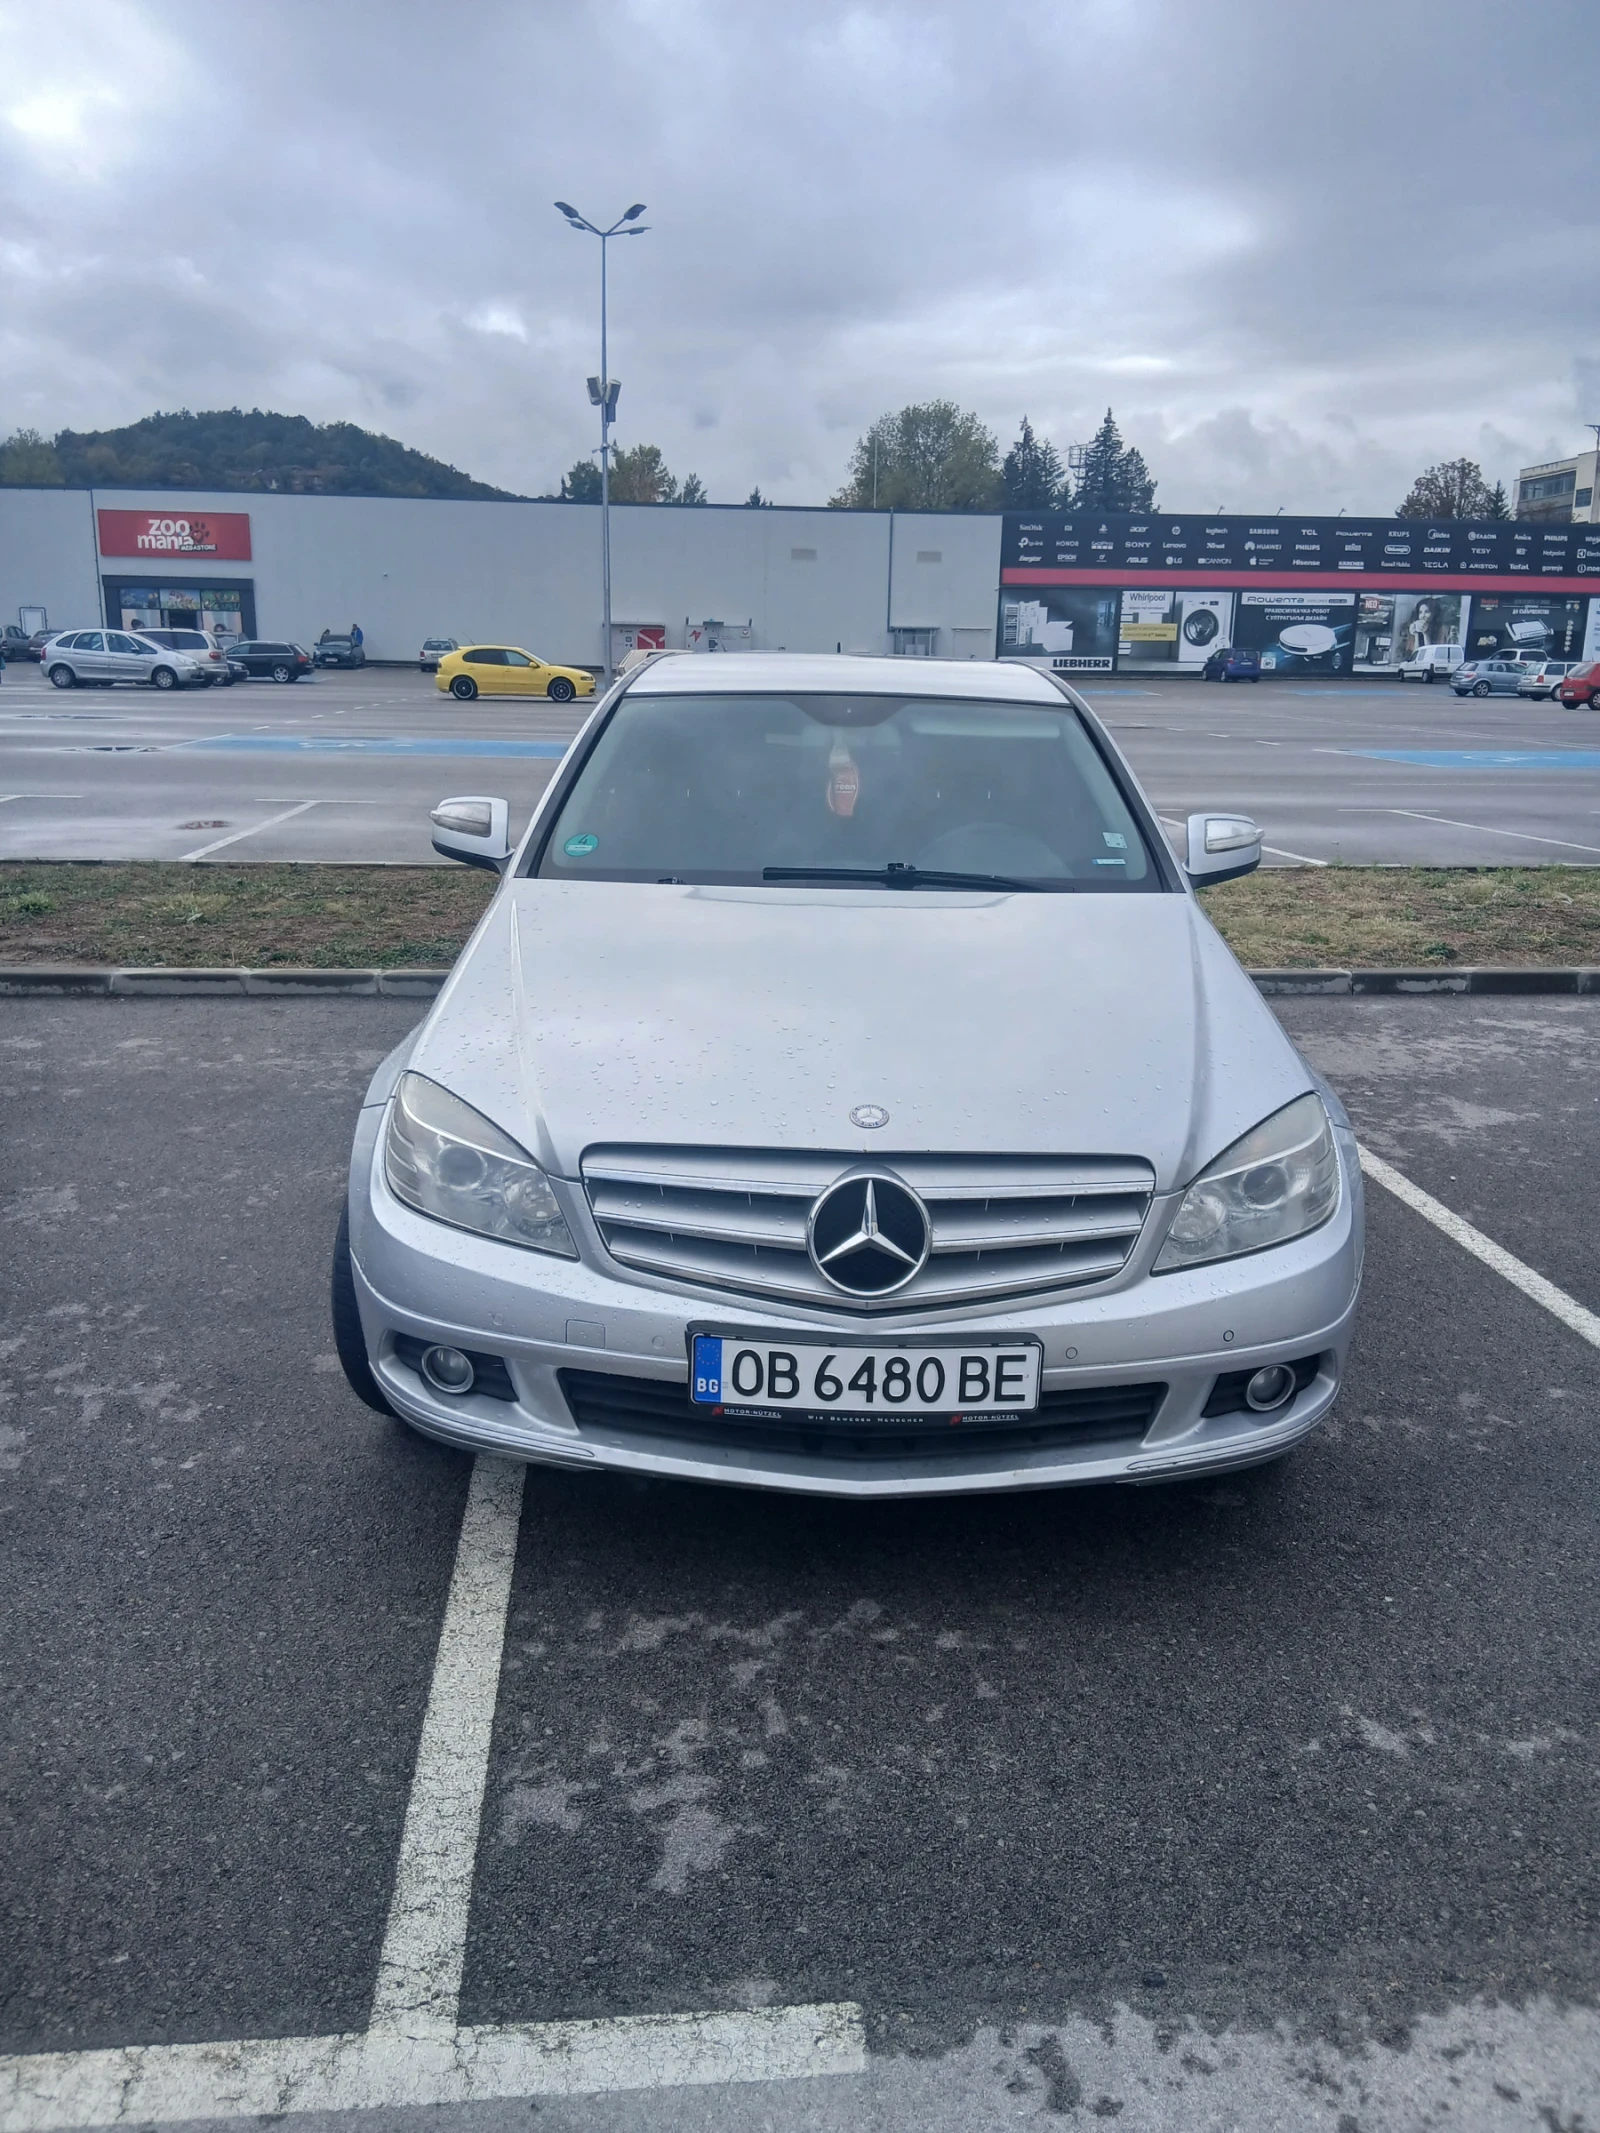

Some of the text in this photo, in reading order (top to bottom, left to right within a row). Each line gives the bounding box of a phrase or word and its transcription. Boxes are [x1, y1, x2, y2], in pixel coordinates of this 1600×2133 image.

[1205, 527, 1228, 536] logitech
[137, 534, 194, 549] mania
[1514, 533, 1532, 541] Amica
[1542, 564, 1564, 573] gorenje
[1129, 593, 1166, 603] Whirlpool
[1247, 596, 1305, 604] Rowenta
[1365, 600, 1378, 608] NEO
[1053, 659, 1110, 668] LIEBHERR
[578, 834, 589, 845] 4
[697, 1349, 1027, 1403] BG OB 6480 BE
